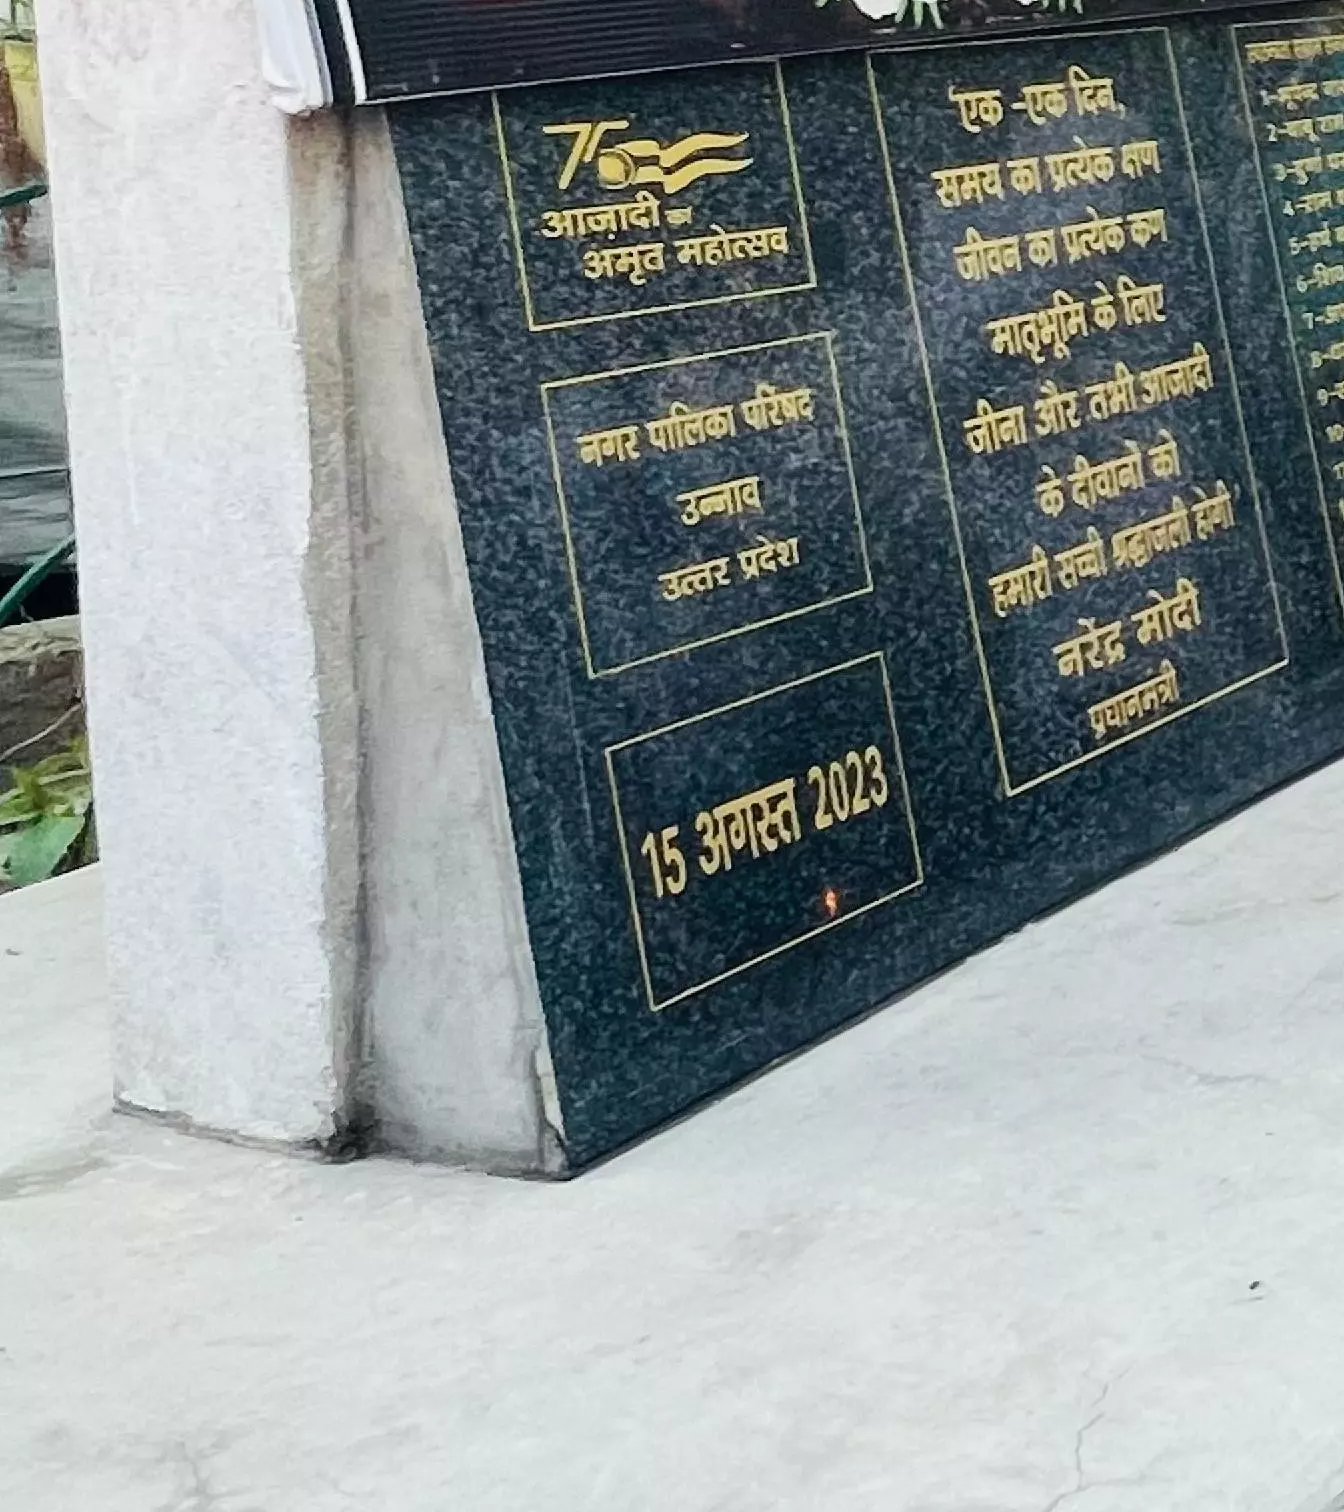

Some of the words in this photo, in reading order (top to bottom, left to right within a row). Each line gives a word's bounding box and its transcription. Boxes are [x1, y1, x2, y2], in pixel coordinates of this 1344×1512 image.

[931, 162, 1005, 208] समय
[1007, 157, 1041, 195] का
[1044, 136, 1114, 193] प्रत्येक
[1121, 140, 1162, 180] क्षण
[583, 242, 665, 286] अमृत
[674, 223, 788, 266] महोत्सव
[953, 227, 1022, 281] जीवन
[1025, 229, 1058, 267] का
[1060, 206, 1126, 263] प्रत्येक
[1127, 208, 1168, 248] कण
[984, 289, 1088, 363] मातृभूमि
[1090, 281, 1117, 331] के
[1118, 275, 1166, 325] लिए
[576, 426, 641, 467] नगर
[644, 401, 736, 452] पालिका
[740, 382, 816, 430] परिषद
[1034, 379, 1082, 437] और
[676, 476, 763, 526] उन्नाव
[1034, 464, 1064, 518] के
[1148, 428, 1181, 478] को
[658, 557, 731, 600] उत्तर
[736, 535, 800, 580] प्रदेश
[988, 545, 1052, 618] हमारी
[1131, 577, 1202, 644] मोदी
[641, 825, 687, 898] 15
[695, 777, 801, 875] अगस्त
[807, 745, 888, 830] 2023
